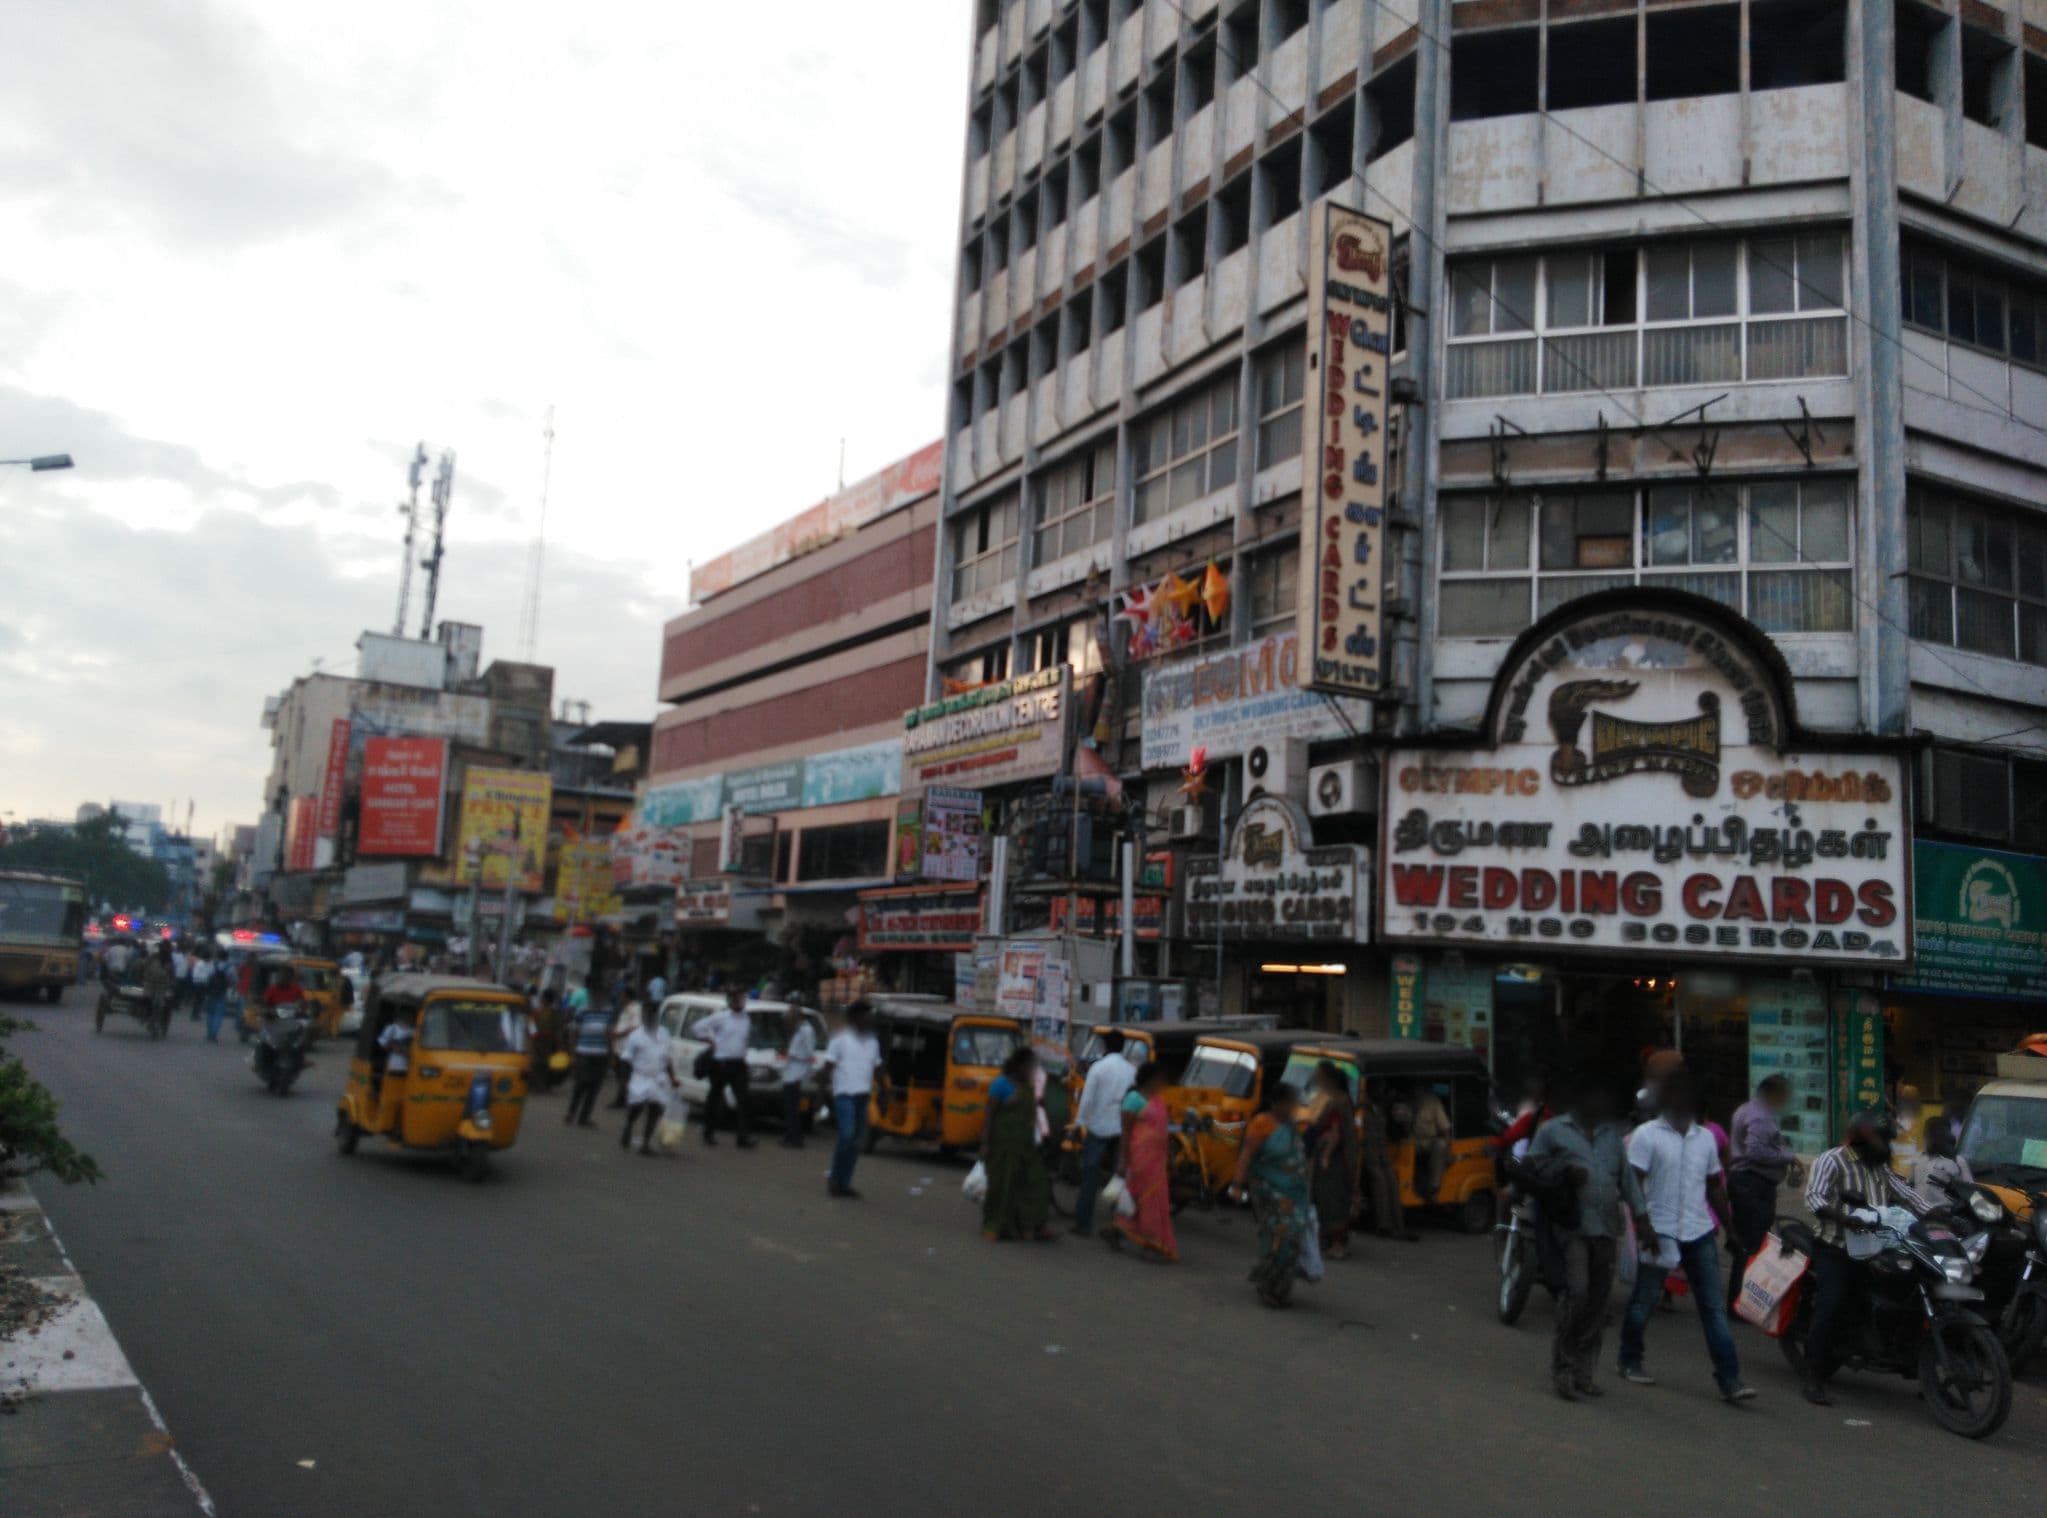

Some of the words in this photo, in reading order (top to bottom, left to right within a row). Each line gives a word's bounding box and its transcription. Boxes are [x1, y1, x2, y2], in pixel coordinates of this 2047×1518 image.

[1323, 310, 1351, 499] WEDDING
[1321, 515, 1342, 652] CARDS
[1399, 766, 1540, 796] OLYMPIC
[1394, 808, 1553, 857] திருமண
[1568, 812, 1892, 869] அழைப்பிதழ்கள்
[1391, 863, 1663, 918] WEDDING
[1682, 872, 1897, 927] CARDS
[1750, 926, 1873, 952] ROAD
